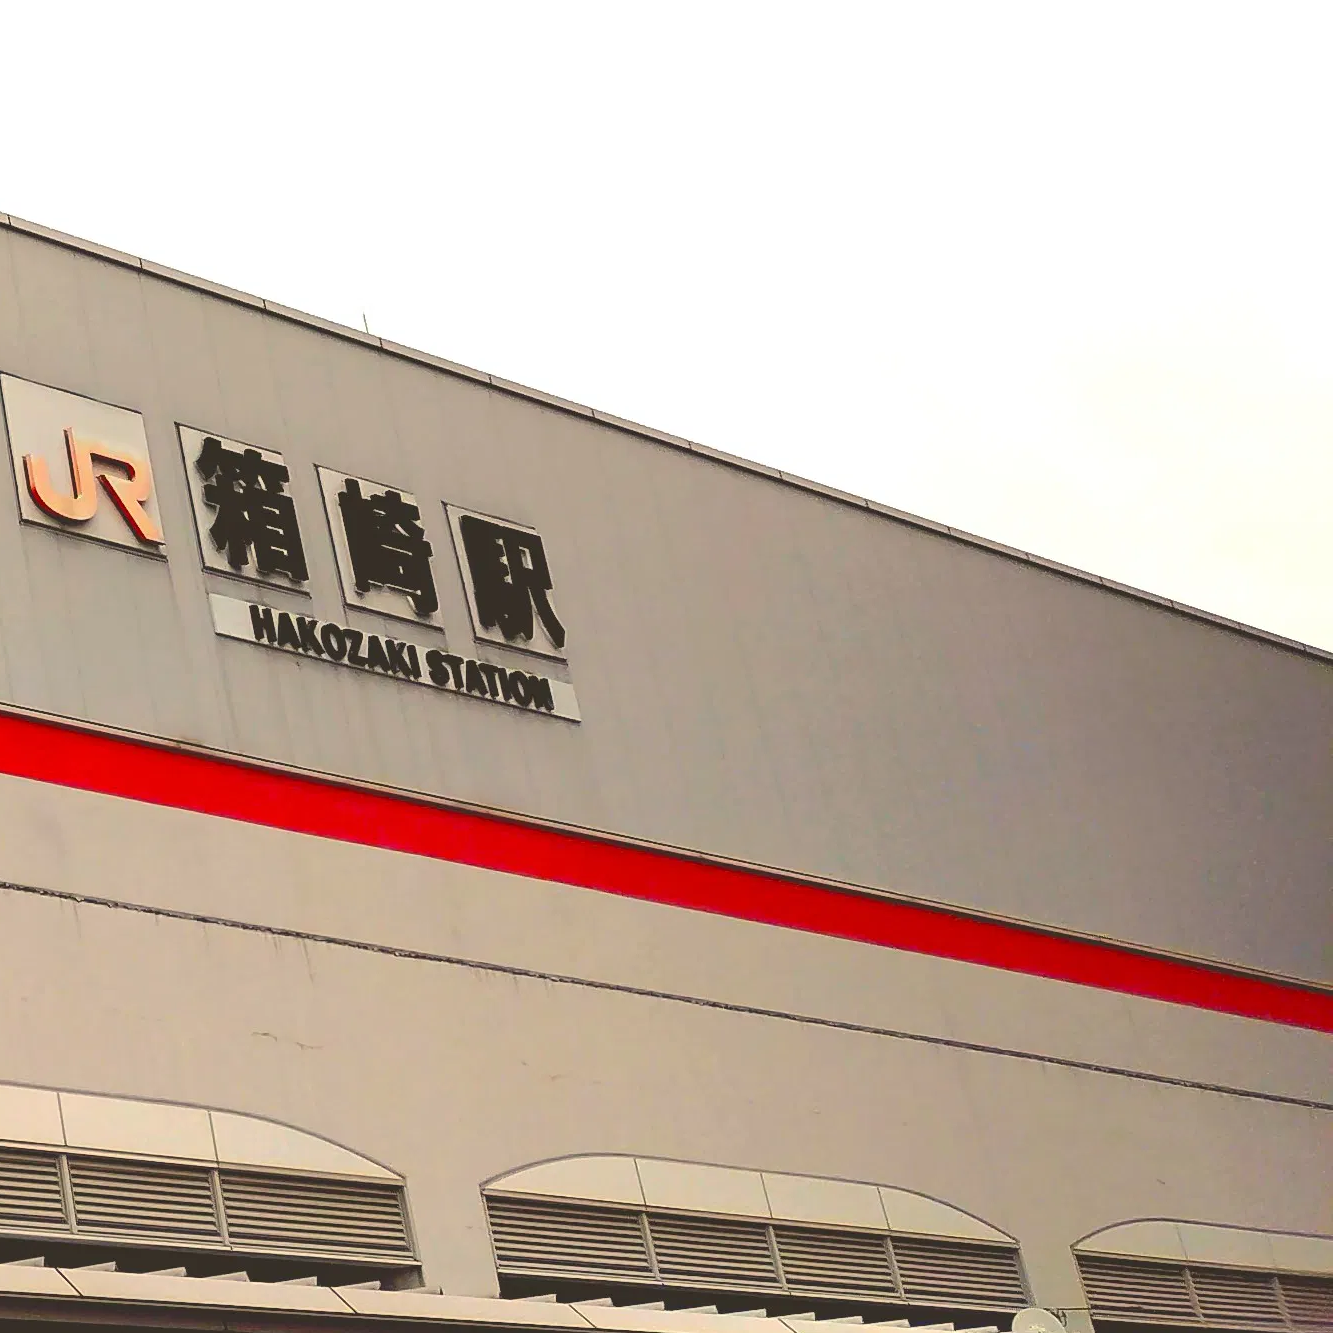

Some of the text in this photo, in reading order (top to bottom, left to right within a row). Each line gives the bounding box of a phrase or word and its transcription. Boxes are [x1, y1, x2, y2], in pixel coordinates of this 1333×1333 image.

[22, 427, 166, 546] JR
[194, 436, 565, 648] 箱崎駅
[249, 604, 555, 711] HAKOZAKI STATION
